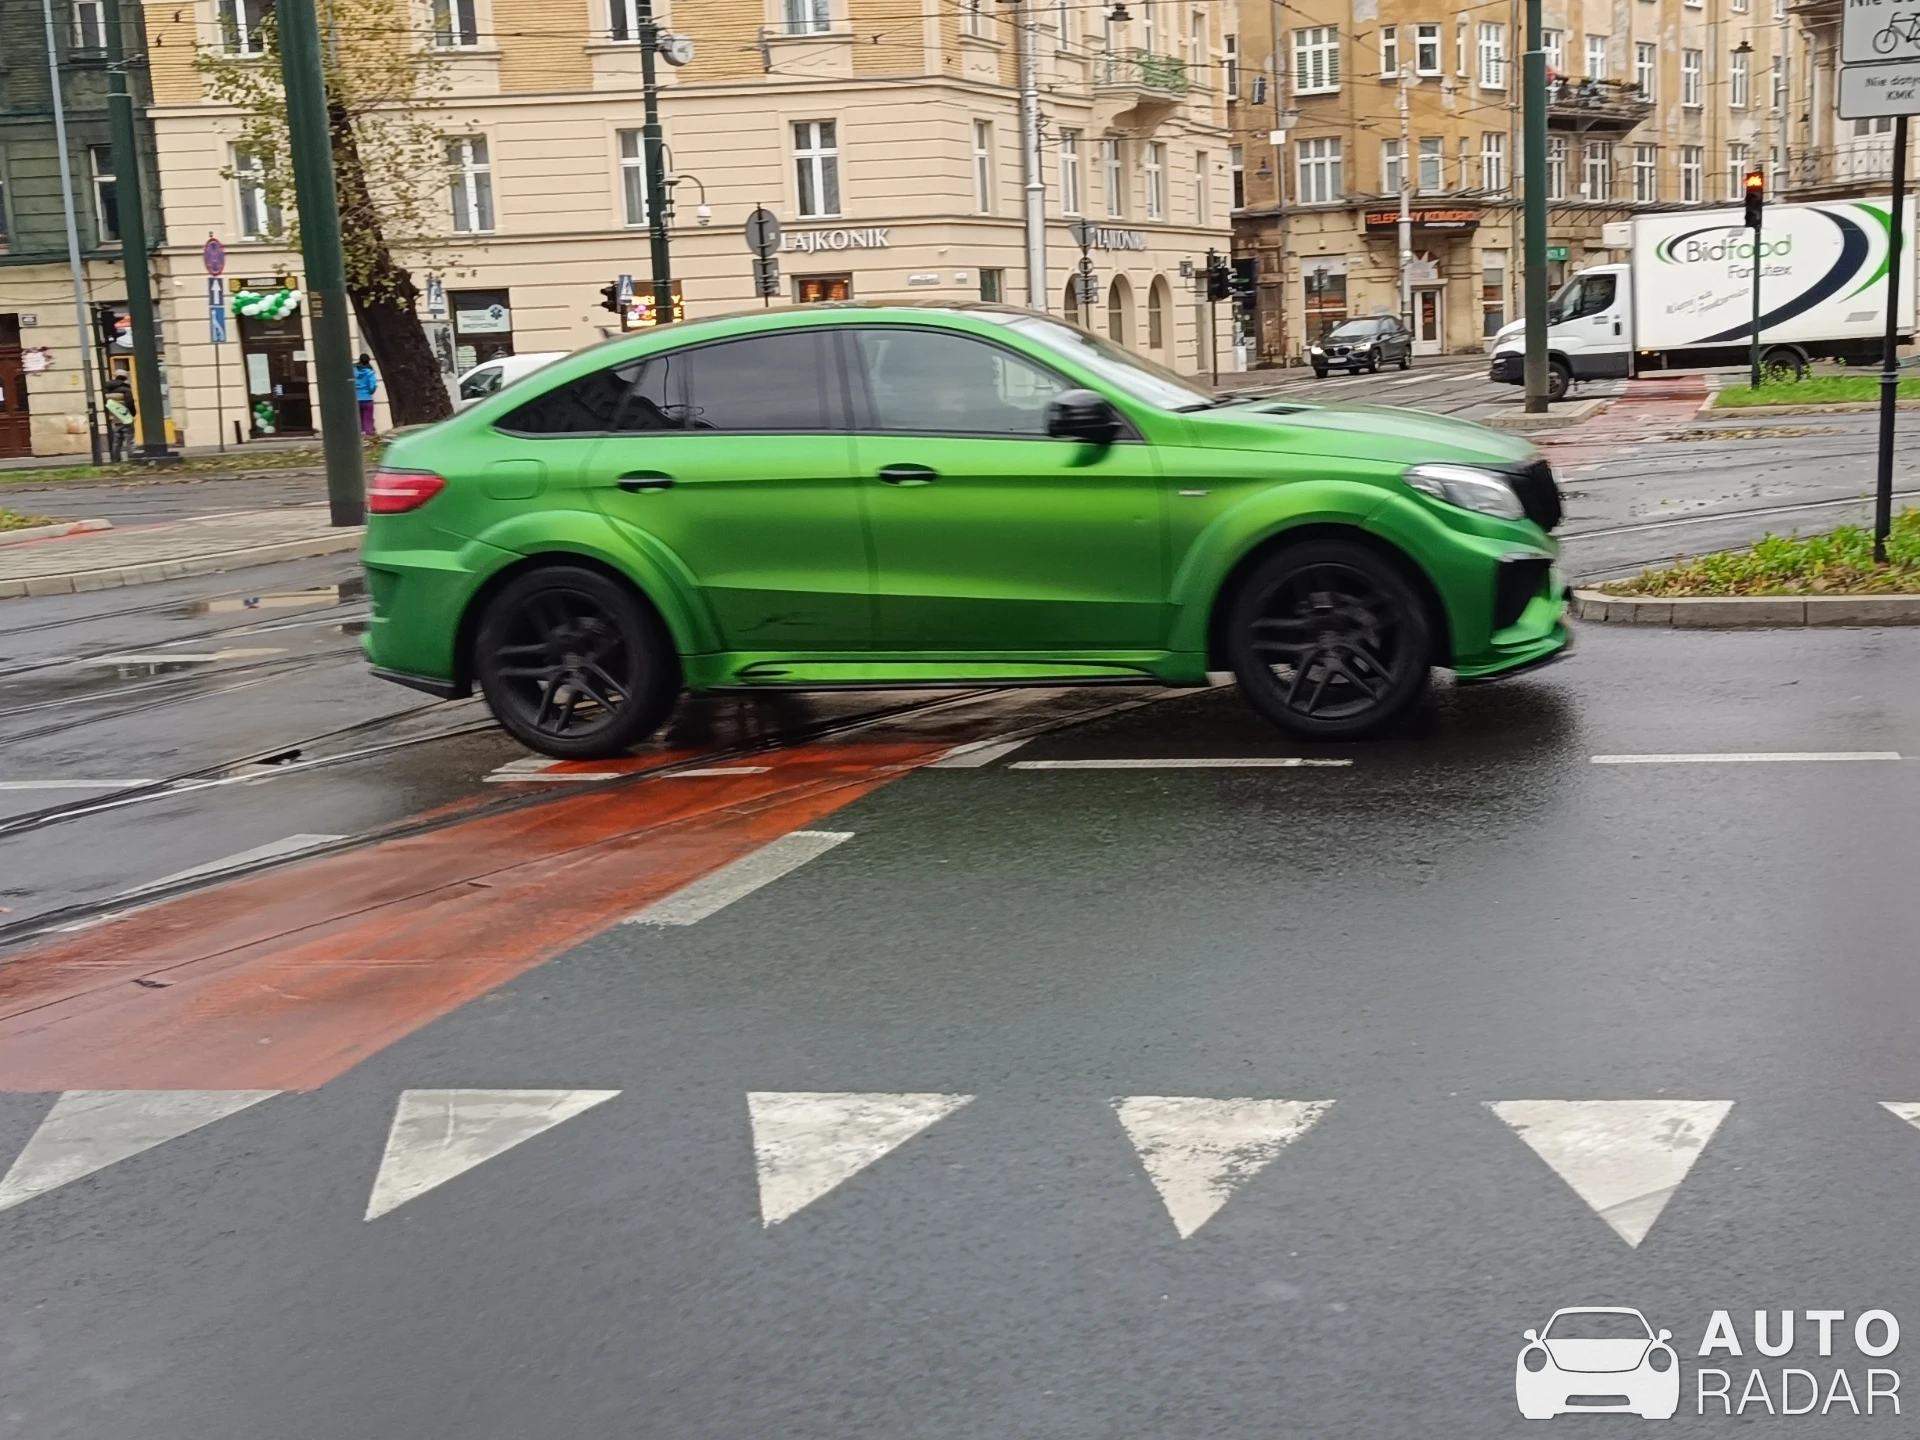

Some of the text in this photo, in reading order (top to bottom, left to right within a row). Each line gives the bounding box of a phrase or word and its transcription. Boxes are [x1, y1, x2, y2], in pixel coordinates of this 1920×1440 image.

[1366, 211, 1423, 225] TELEFNY
[781, 228, 890, 254] LAJKONIK
[1686, 233, 1792, 263] Bidfood
